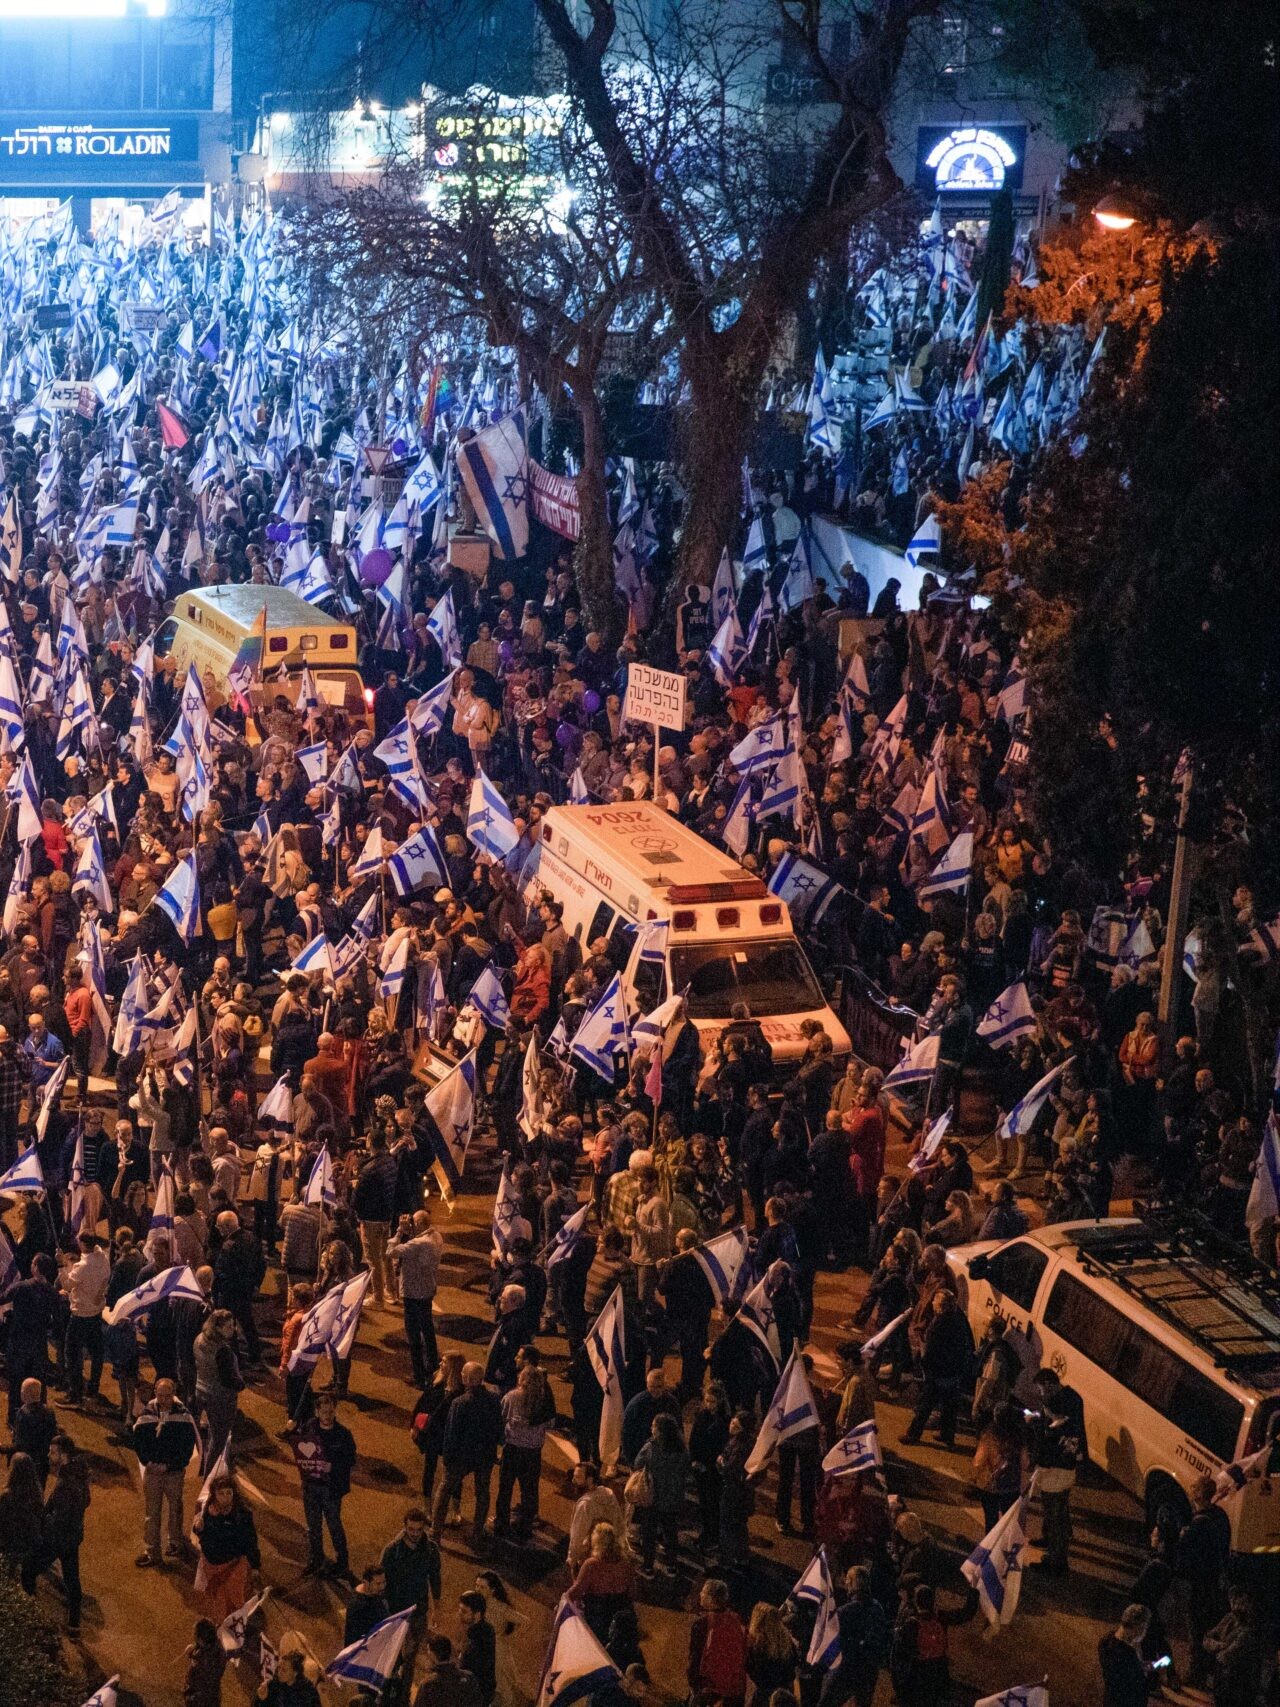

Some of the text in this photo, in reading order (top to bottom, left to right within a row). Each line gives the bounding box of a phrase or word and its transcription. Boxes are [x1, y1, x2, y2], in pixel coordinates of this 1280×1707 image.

[75, 135, 171, 155] ROLADIN
[52, 386, 80, 400] כלא
[634, 668, 679, 692] ממשלה
[630, 684, 679, 711] בהפרעה
[631, 701, 674, 725] הביתה!
[586, 811, 651, 826] 2604
[985, 1297, 1023, 1330] POLICE
[1175, 1444, 1213, 1476] משטרה
